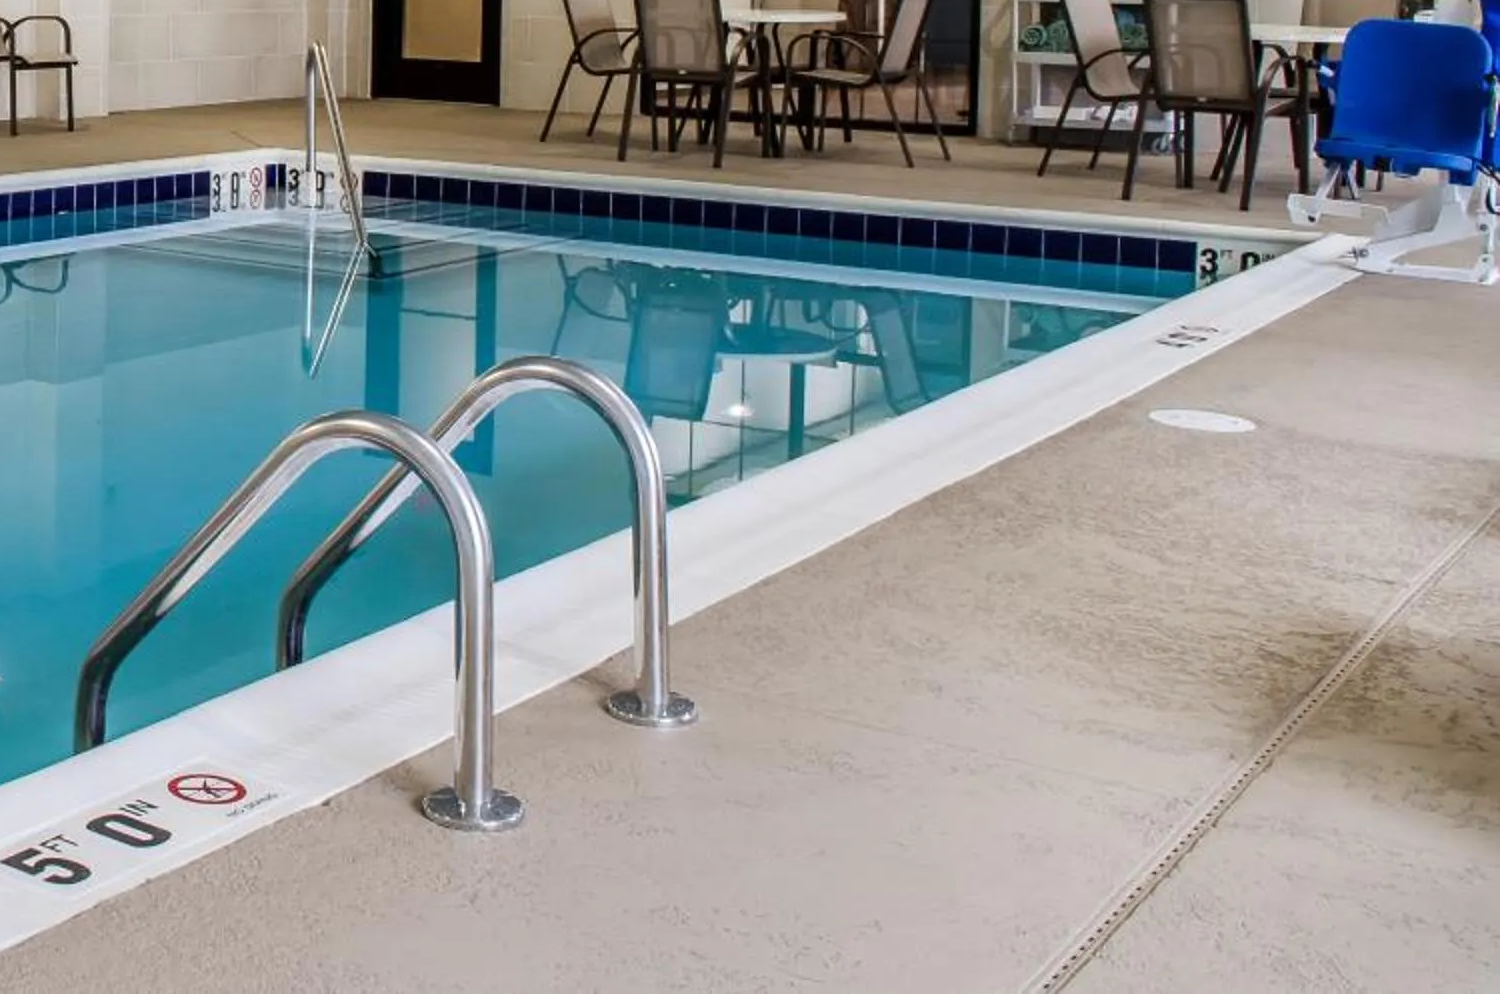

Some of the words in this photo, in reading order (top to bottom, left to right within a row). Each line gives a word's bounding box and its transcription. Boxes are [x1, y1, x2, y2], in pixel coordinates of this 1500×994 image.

[1200, 248, 1218, 273] 3
[118, 799, 159, 817] IN
[39, 833, 82, 853] FT
[86, 813, 173, 848] 0
[0, 847, 93, 885] 5
